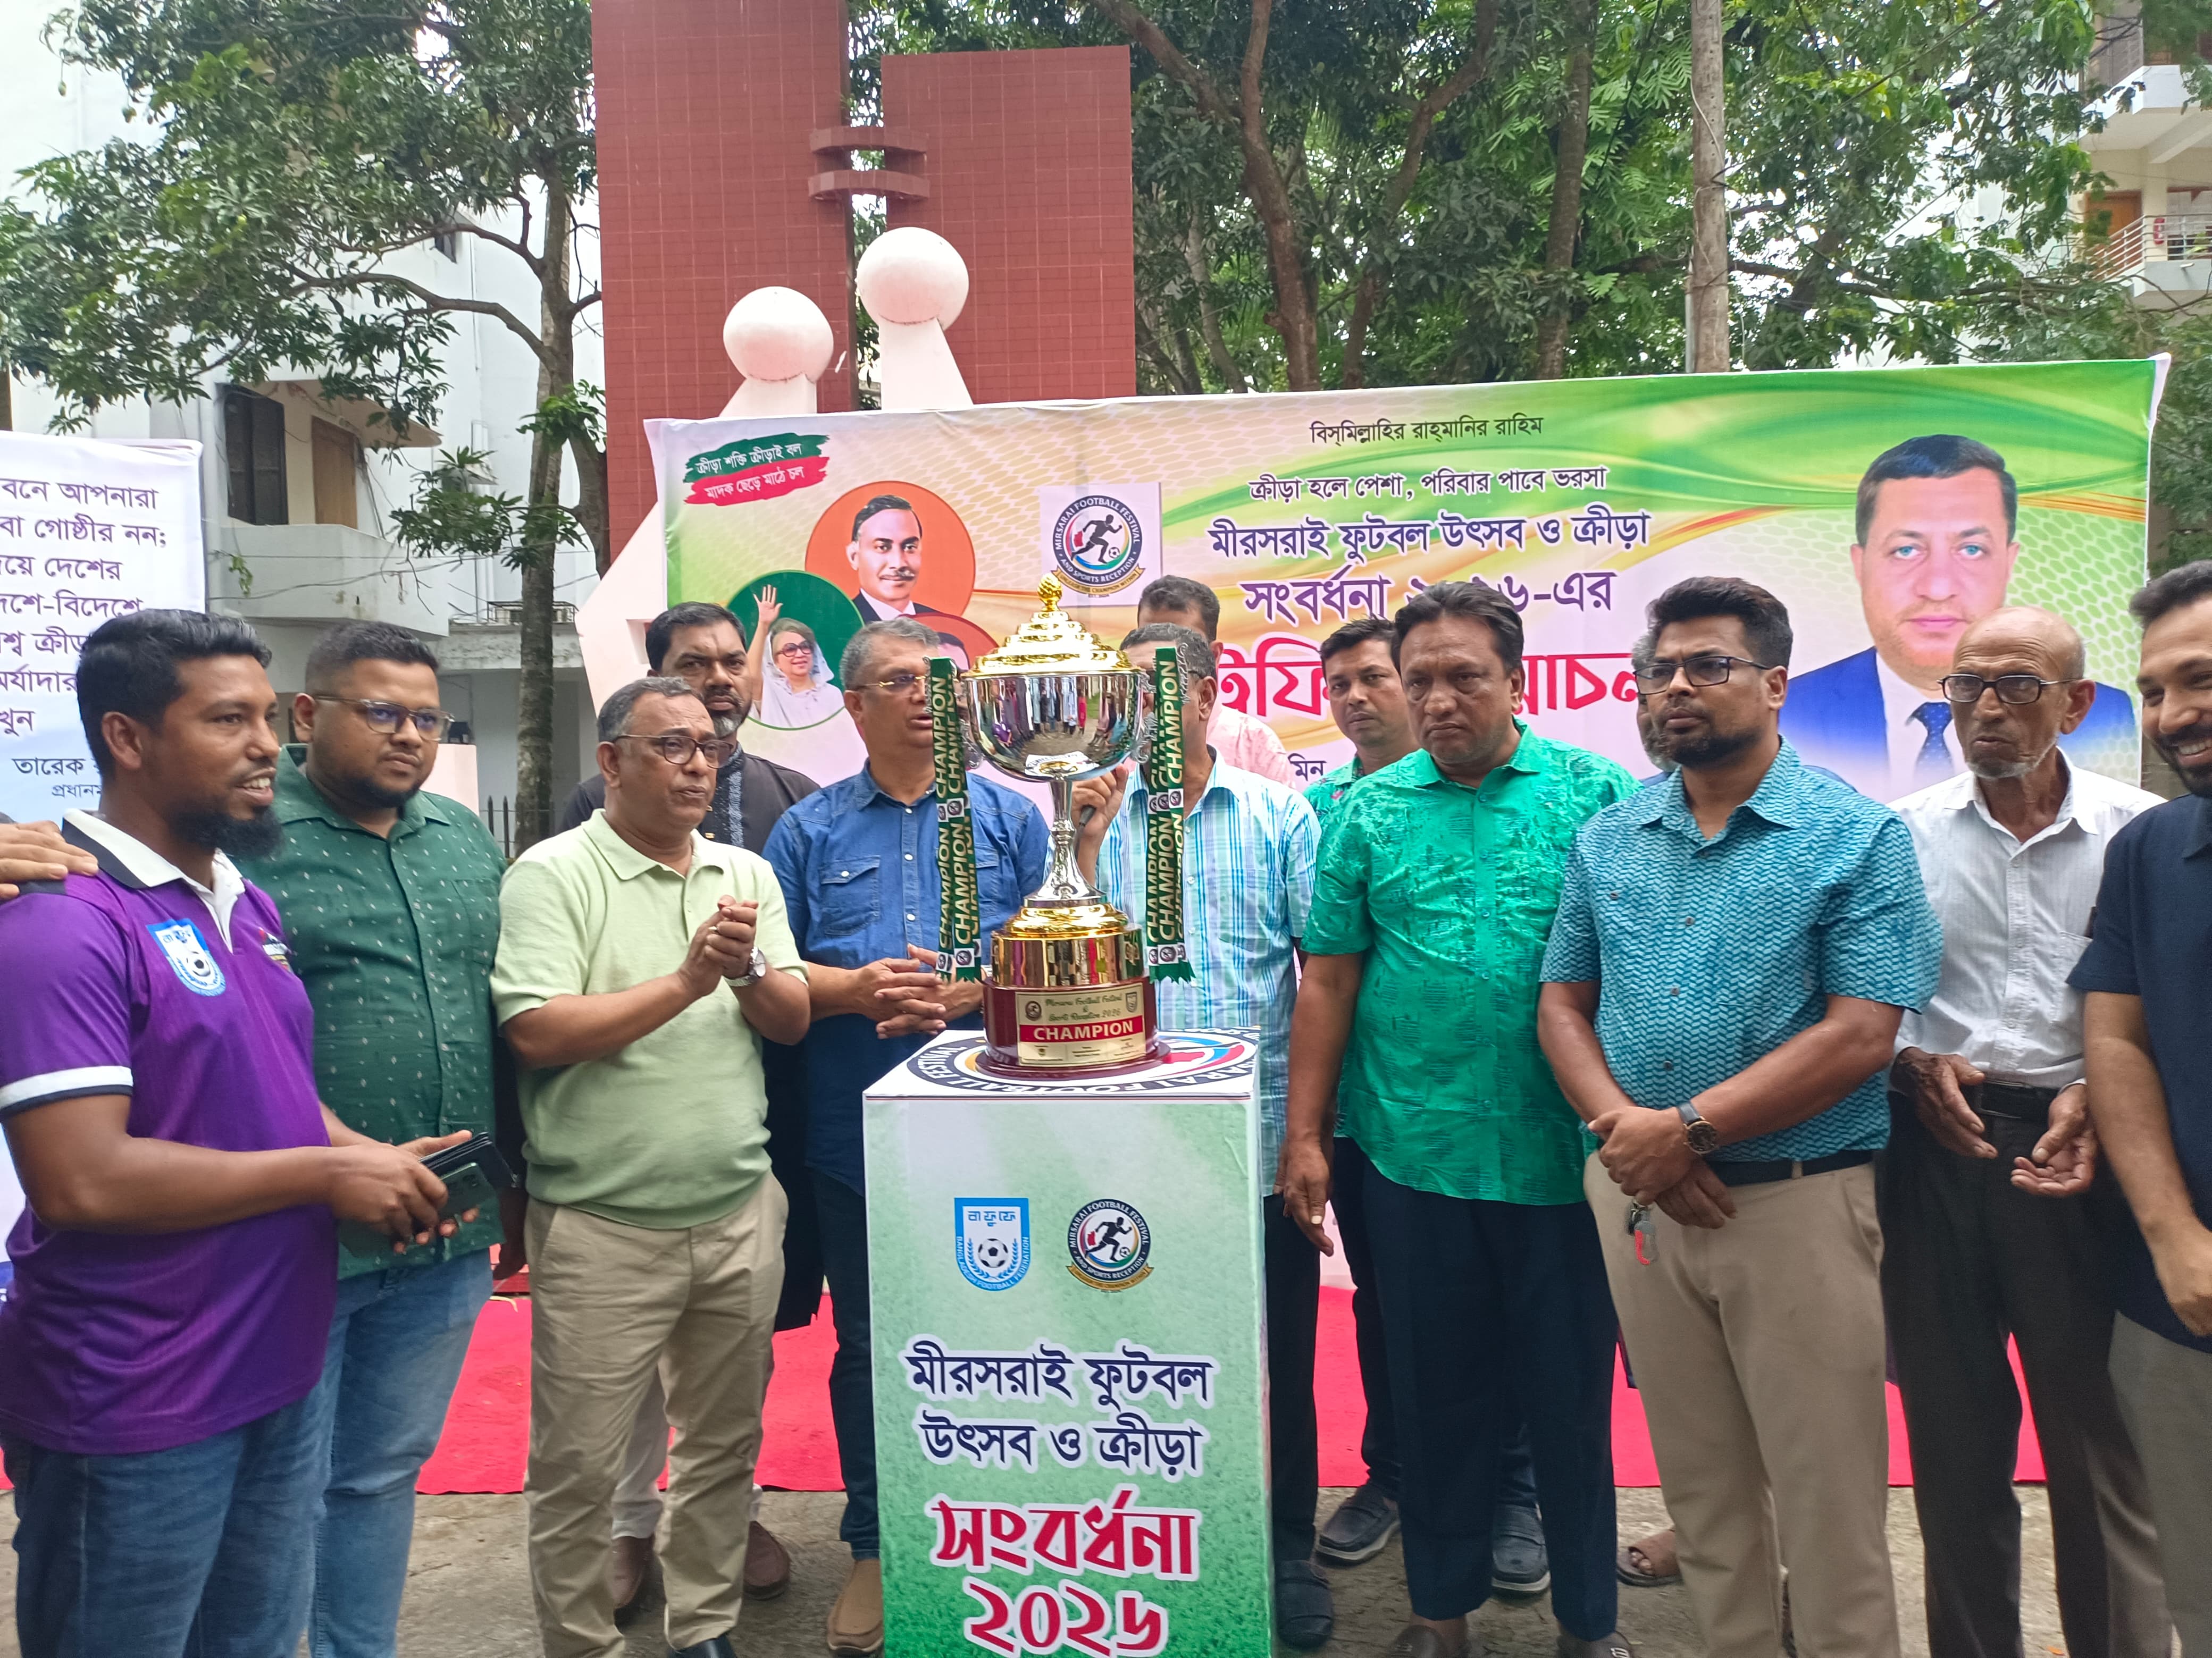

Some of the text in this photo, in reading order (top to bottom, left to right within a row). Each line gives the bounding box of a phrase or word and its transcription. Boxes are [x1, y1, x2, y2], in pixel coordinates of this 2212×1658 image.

[1494, 412, 1544, 436] রাহিম
[695, 457, 722, 474] ক্রীড়া
[784, 443, 802, 455] বল
[704, 466, 805, 499] মাদক ছেড়ে মাঠে চল
[56, 482, 160, 510] আপনারা
[1249, 474, 1302, 503] ক্রীড়া
[1307, 478, 1350, 499] হলে
[1421, 468, 1492, 494] পরিবার
[1498, 470, 1546, 491] পাবে
[1552, 466, 1607, 488] ভরসা
[35, 512, 116, 543] গোষ্ঠীর
[1054, 497, 1141, 550] MIRSARAI FOOTBALL FESTIVAL
[1208, 504, 1652, 564] মীরসরাই ফুটবল উৎসব ও ক্রীড়া
[45, 558, 123, 581] দেশের
[1061, 558, 1074, 573] AND
[1100, 557, 1135, 582] RECEPTION
[1239, 565, 1392, 624] সংবর্ধনা
[932, 676, 948, 798] CHAMPION
[1159, 661, 1183, 784] CHAMPION
[12, 757, 86, 776] তারেক
[937, 827, 952, 950] CHAMPION
[950, 822, 972, 945] CHAMPION
[1158, 816, 1175, 941] CHAMPION
[1034, 1020, 1133, 1040] CHAMPION
[917, 1046, 967, 1079] FESTIVAL
[1087, 1201, 1130, 1214] FOOTBALL
[1129, 1211, 1150, 1245] FESTIVAL
[904, 1340, 1213, 1412] মীরসরাই ফুটবল
[919, 1410, 1203, 1476] উৎসব ও ক্রীড়া
[931, 1489, 1195, 1575] সংবর্ধনা
[969, 1583, 1161, 1657] ২০২৬
